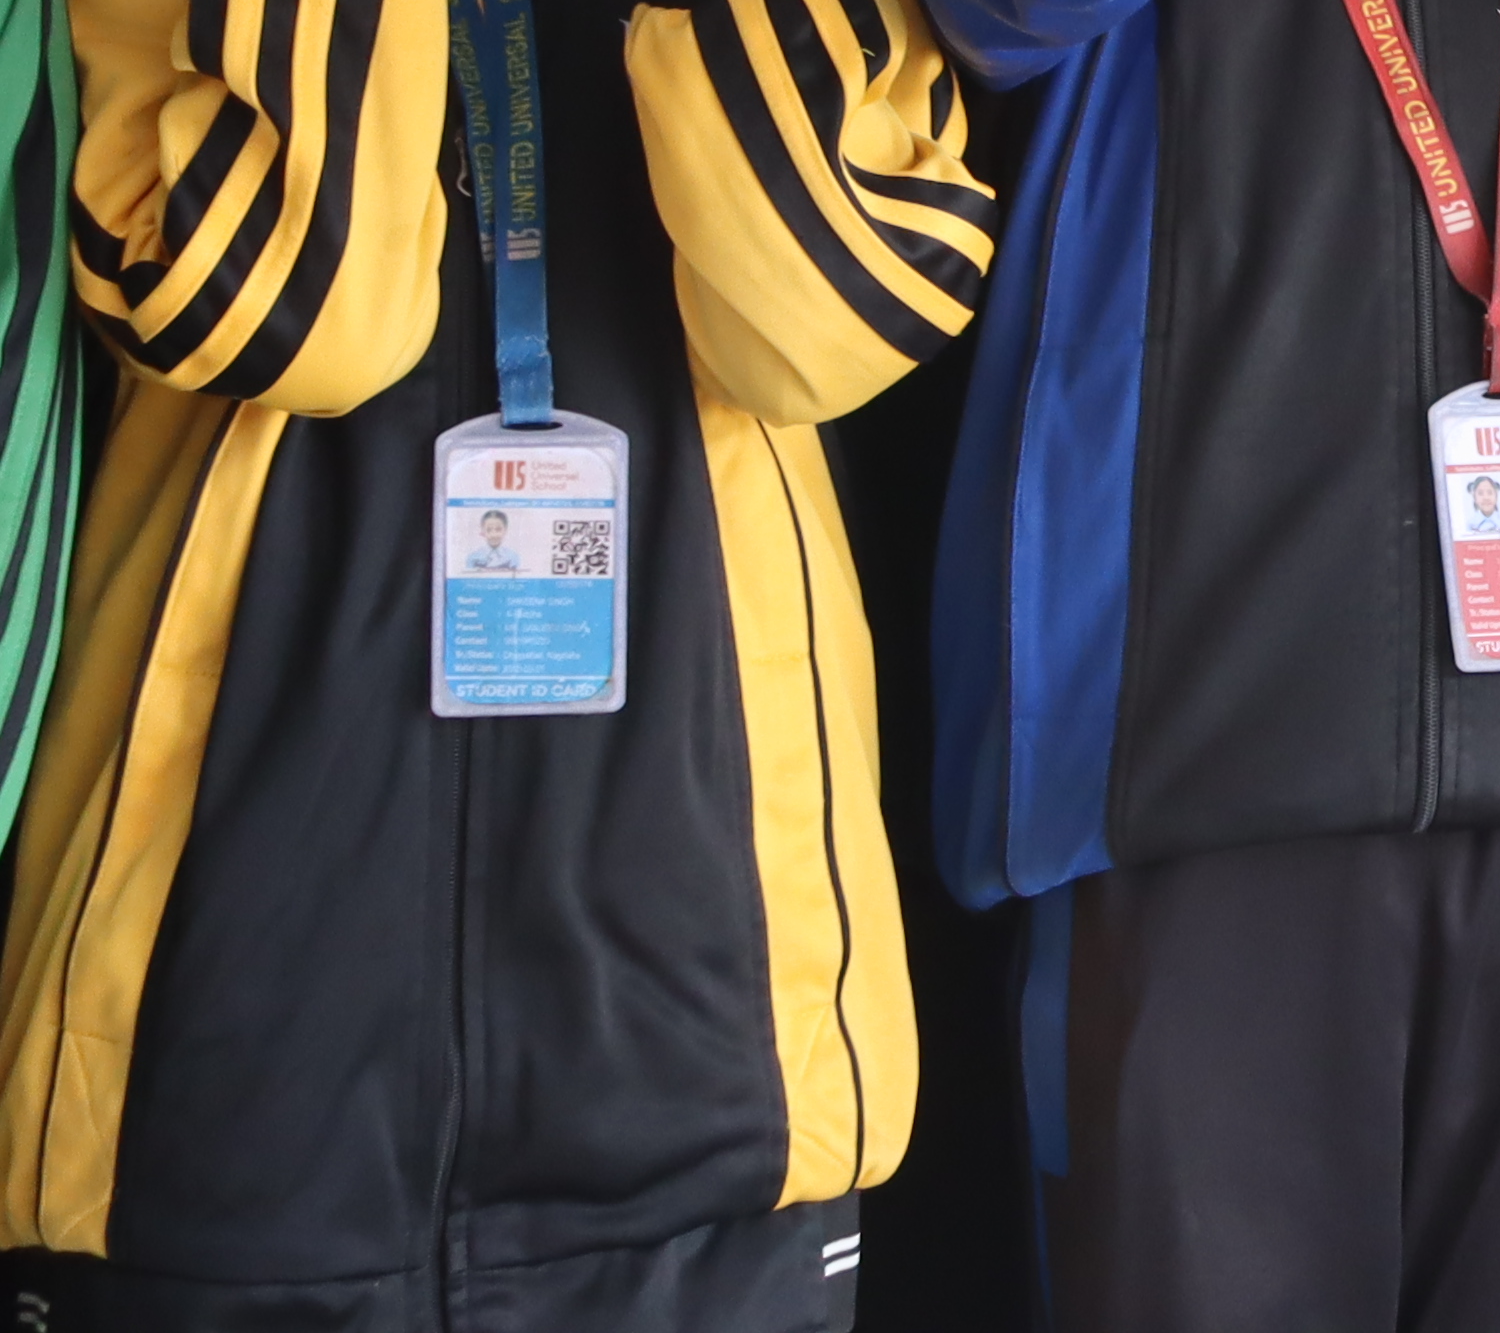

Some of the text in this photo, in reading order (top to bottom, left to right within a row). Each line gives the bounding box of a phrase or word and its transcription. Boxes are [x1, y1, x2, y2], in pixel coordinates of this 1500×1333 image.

[1403, 100, 1459, 198] UNITED
[456, 684, 527, 698] STUDENT
[551, 683, 598, 697] CARD
